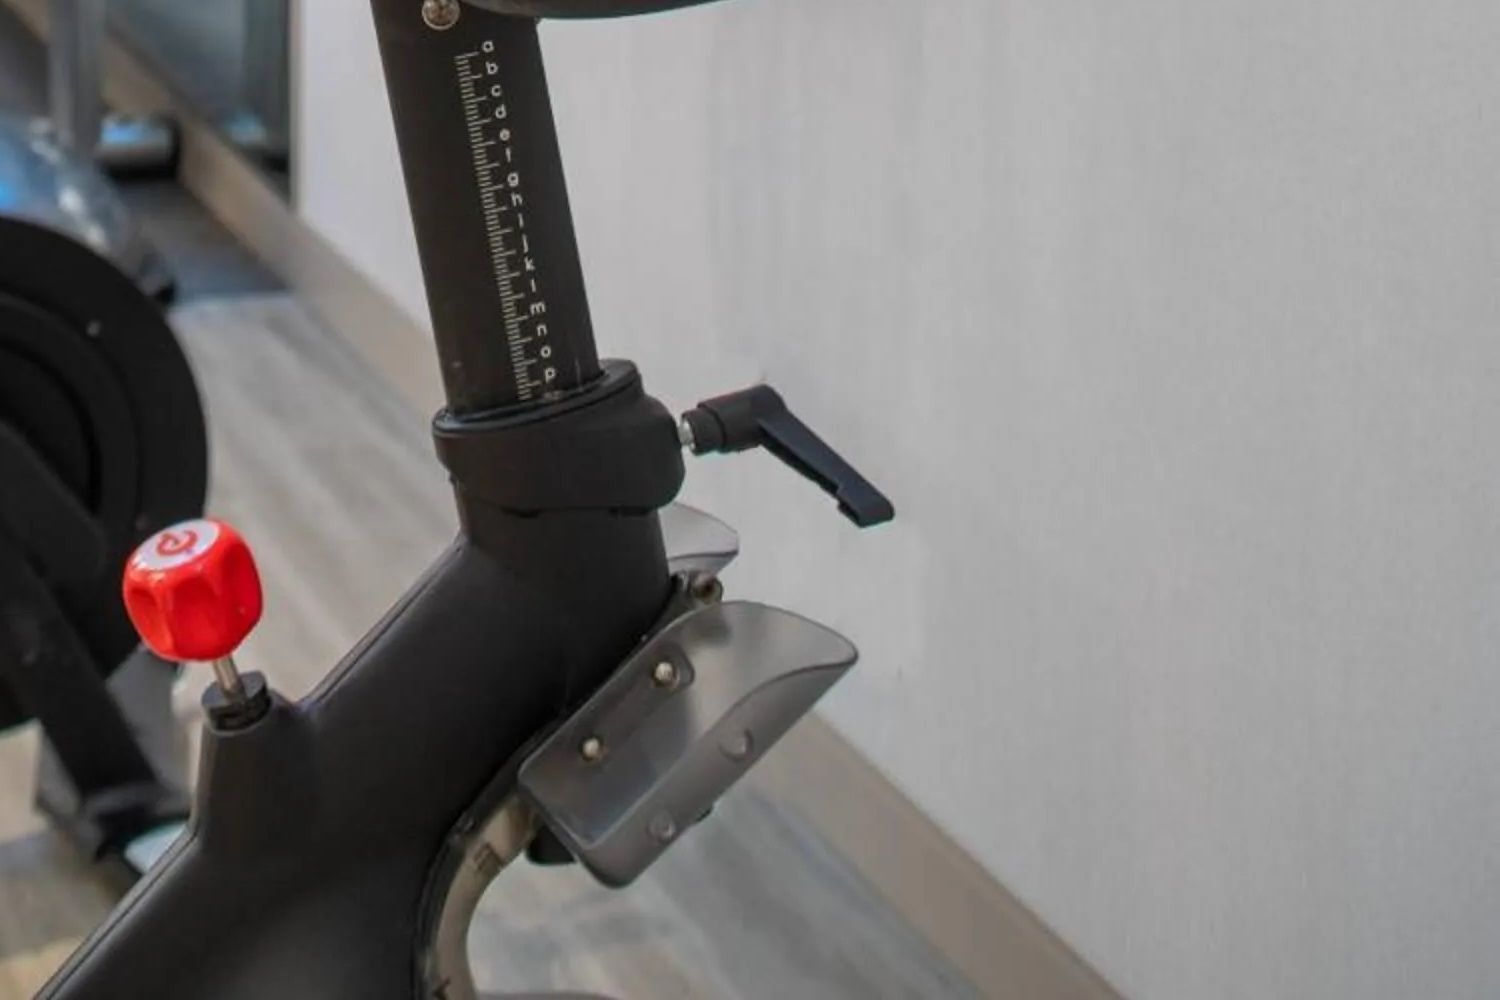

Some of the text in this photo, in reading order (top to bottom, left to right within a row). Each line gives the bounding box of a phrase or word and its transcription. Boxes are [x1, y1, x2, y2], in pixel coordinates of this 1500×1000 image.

[485, 61, 498, 75] b
[490, 84, 501, 97] c
[495, 104, 507, 119] d
[530, 301, 546, 315] m
[537, 324, 547, 337] n
[545, 368, 556, 384] p
